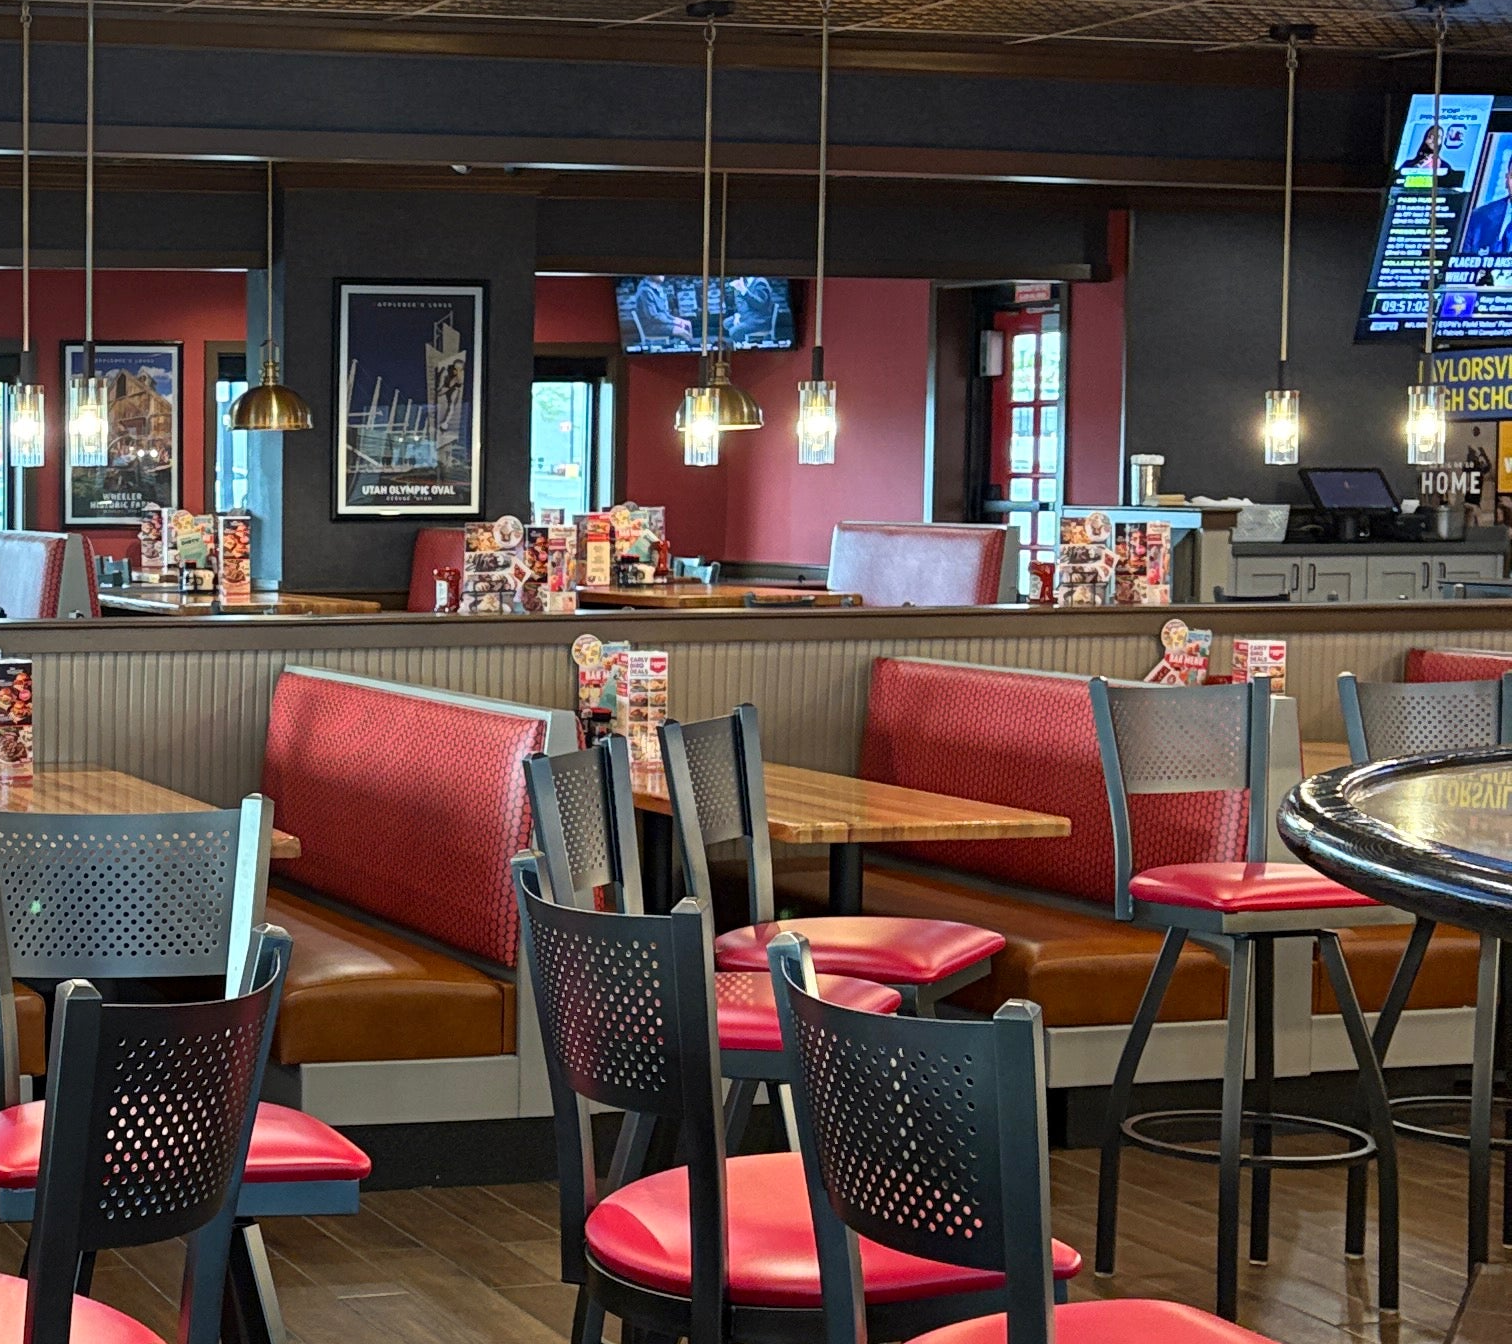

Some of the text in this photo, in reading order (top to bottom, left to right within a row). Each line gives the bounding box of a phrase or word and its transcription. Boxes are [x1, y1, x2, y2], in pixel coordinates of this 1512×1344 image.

[1448, 257, 1481, 268] PLACED
[1419, 354, 1512, 384] YLORSVI
[1421, 472, 1481, 494] HOME
[103, 492, 142, 500] WHEELER
[362, 485, 456, 496] UTAH OLYMPIC OVAL
